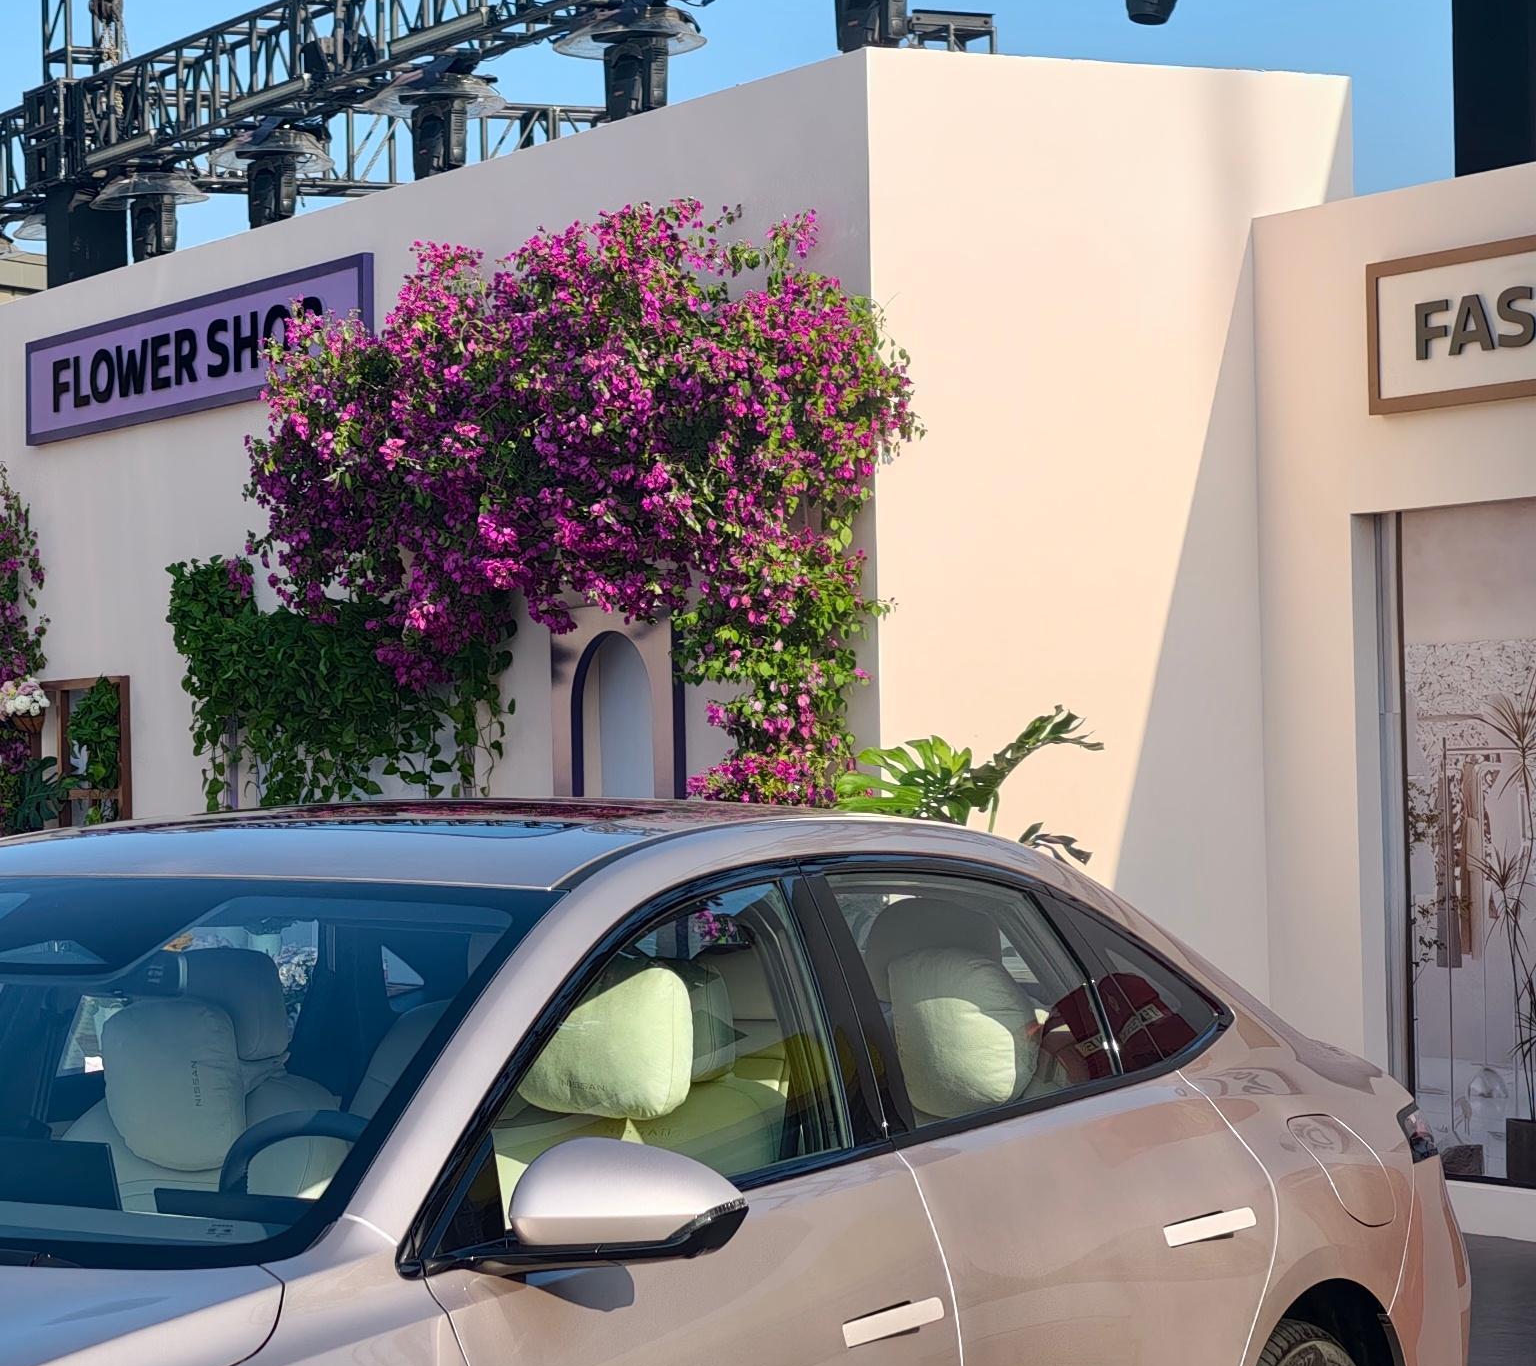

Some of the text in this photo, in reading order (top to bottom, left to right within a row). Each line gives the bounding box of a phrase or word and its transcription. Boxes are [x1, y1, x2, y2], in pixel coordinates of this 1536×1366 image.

[1415, 285, 1536, 361] FAS
[52, 328, 198, 413] FLOWER
[190, 1059, 203, 1107] NISSAN
